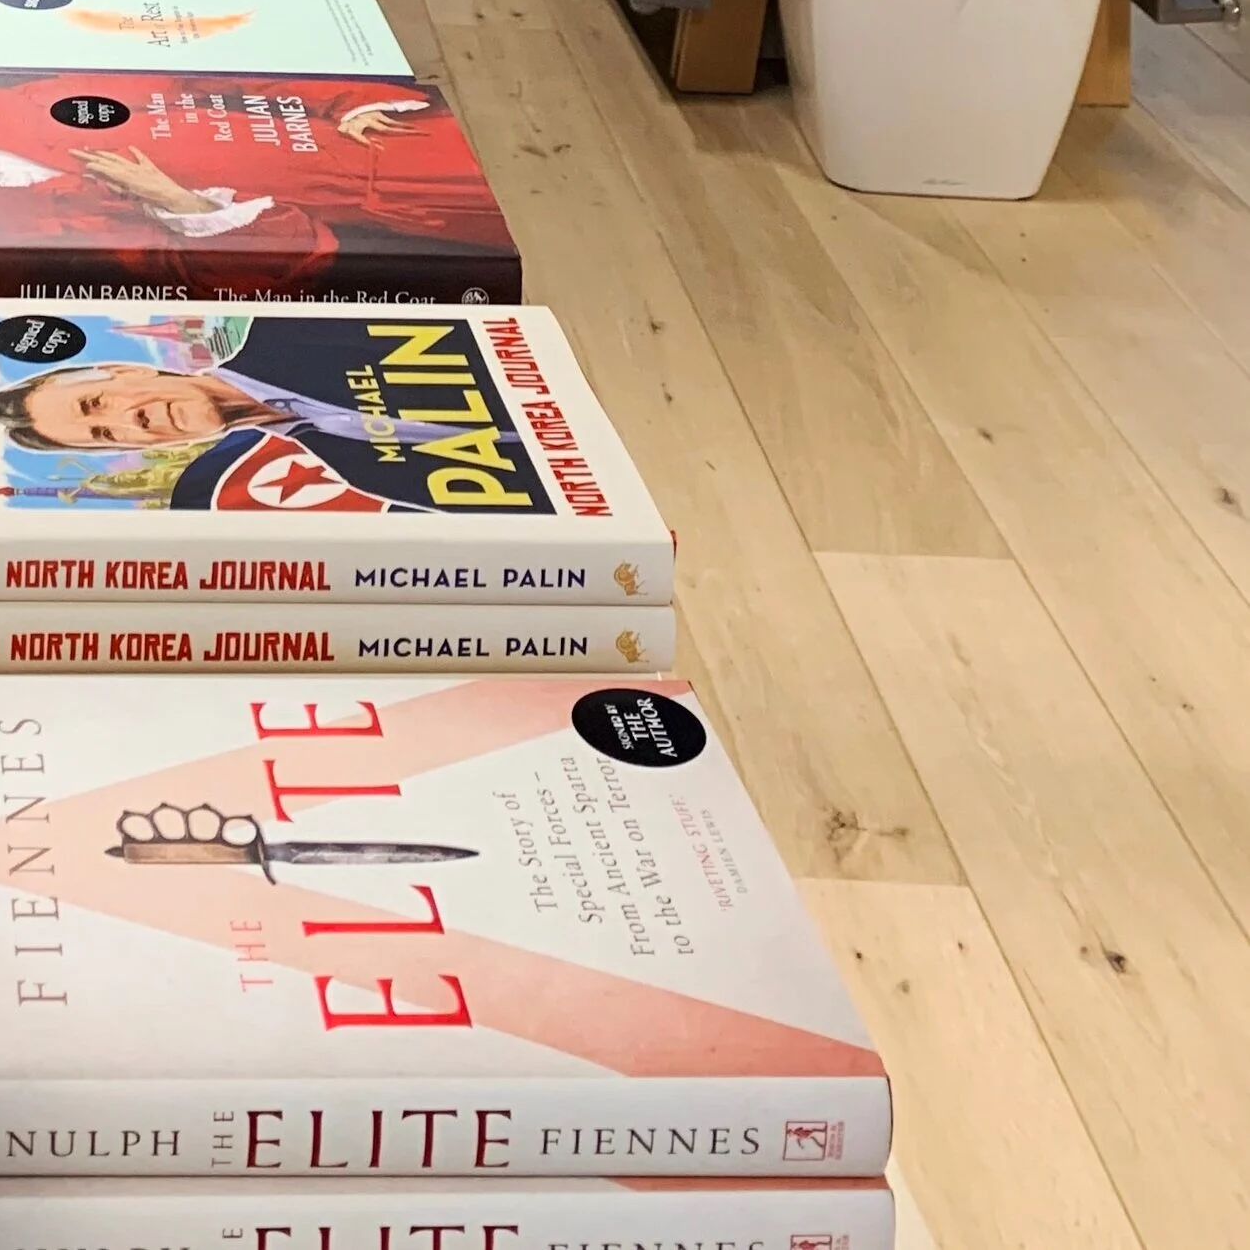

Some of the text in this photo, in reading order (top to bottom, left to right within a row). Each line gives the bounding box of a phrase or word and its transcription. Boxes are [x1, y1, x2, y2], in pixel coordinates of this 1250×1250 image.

[119, 16, 135, 31] The
[139, 2, 164, 22] Rest
[145, 31, 171, 48] Art
[72, 100, 94, 124] signed
[96, 103, 114, 123] copy
[147, 93, 172, 139] The Man
[176, 93, 199, 124] in the
[206, 94, 234, 141] Red Coat
[242, 94, 281, 147] JULIAN
[277, 95, 319, 152] BARNES
[101, 285, 188, 301] BARNES
[214, 288, 249, 302] The
[254, 289, 293, 303] Man
[300, 289, 316, 303] in
[322, 289, 351, 303] the
[357, 290, 389, 304] Red
[11, 319, 45, 354] signed
[41, 327, 70, 354] copy
[345, 364, 406, 463] MICHAEL
[367, 325, 533, 507] PALIN
[483, 317, 613, 516] NORTH KOREA JOURNAL
[6, 560, 586, 592] NORTH KOREA JOURNAL MICHAEL PALIN
[10, 632, 588, 663] NORTH KOREA JOURNAL MICHAEL PALIN
[610, 715, 635, 750] SIGNED
[623, 712, 650, 742] THE
[637, 697, 679, 758] AUTHOR
[511, 814, 543, 868] Story
[701, 808, 724, 844] LEWIS
[0, 715, 69, 1008] FIENNES
[249, 699, 474, 1031] ELITE
[537, 787, 603, 924] Special Forces
[561, 757, 656, 957] From Ancient Sparta
[596, 757, 695, 955] to the War on Terror
[529, 873, 559, 913] The
[230, 916, 276, 993] THE
[211, 1109, 236, 1168] THE
[245, 1108, 512, 1169] ELITE
[540, 1126, 760, 1155] FIENNES
